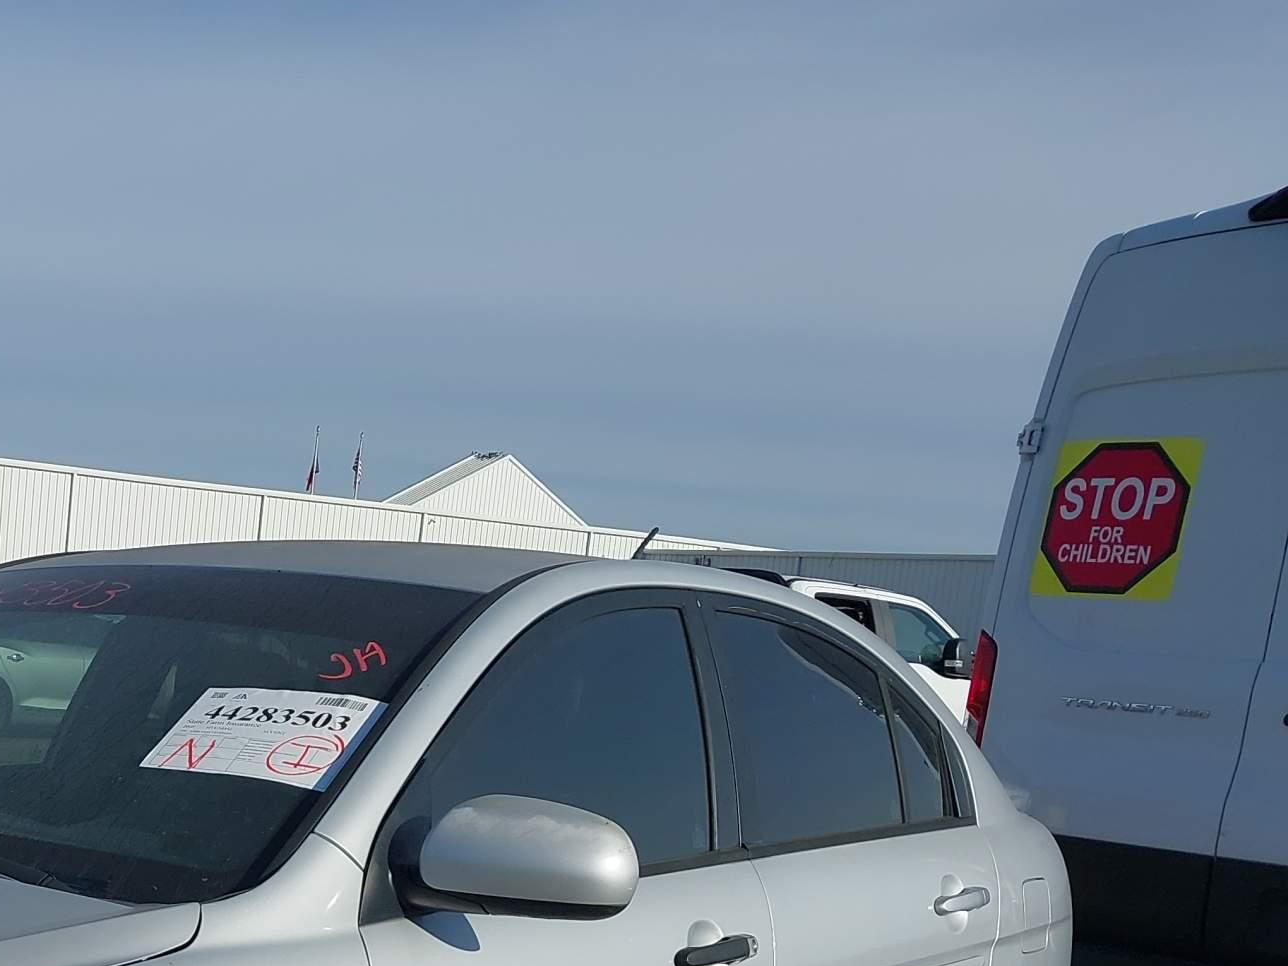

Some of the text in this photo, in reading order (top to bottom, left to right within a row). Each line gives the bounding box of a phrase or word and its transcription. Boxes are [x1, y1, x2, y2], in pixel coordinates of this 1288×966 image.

[1059, 477, 1176, 521] STOP
[1089, 526, 1124, 543] FOR
[1057, 544, 1151, 565] CHILDREN
[1061, 696, 1175, 714] TRANSIT
[204, 704, 352, 732] 44283503
